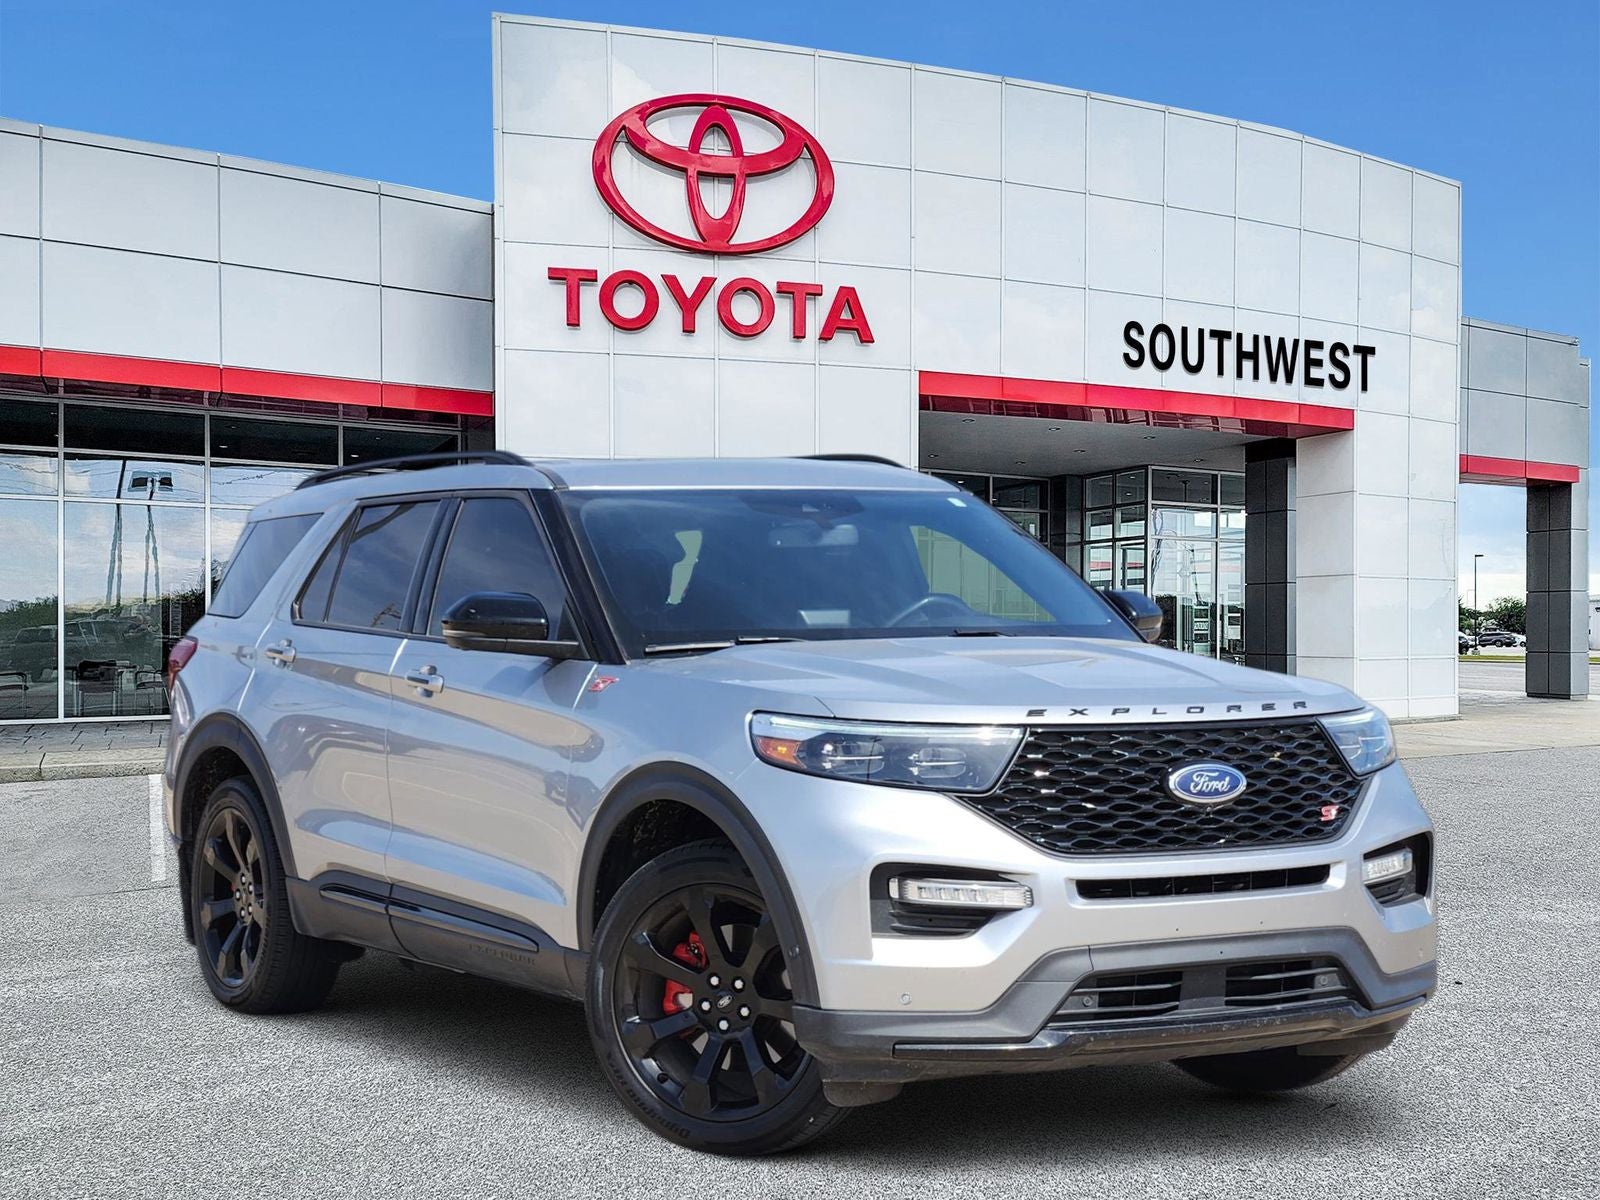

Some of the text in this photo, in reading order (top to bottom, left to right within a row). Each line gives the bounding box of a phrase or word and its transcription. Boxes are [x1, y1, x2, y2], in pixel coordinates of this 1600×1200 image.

[548, 267, 875, 343] TOYOTA
[1123, 321, 1376, 391] SOUTHWEST
[1026, 701, 1307, 717] EXPLORER
[1190, 772, 1231, 793] Ford
